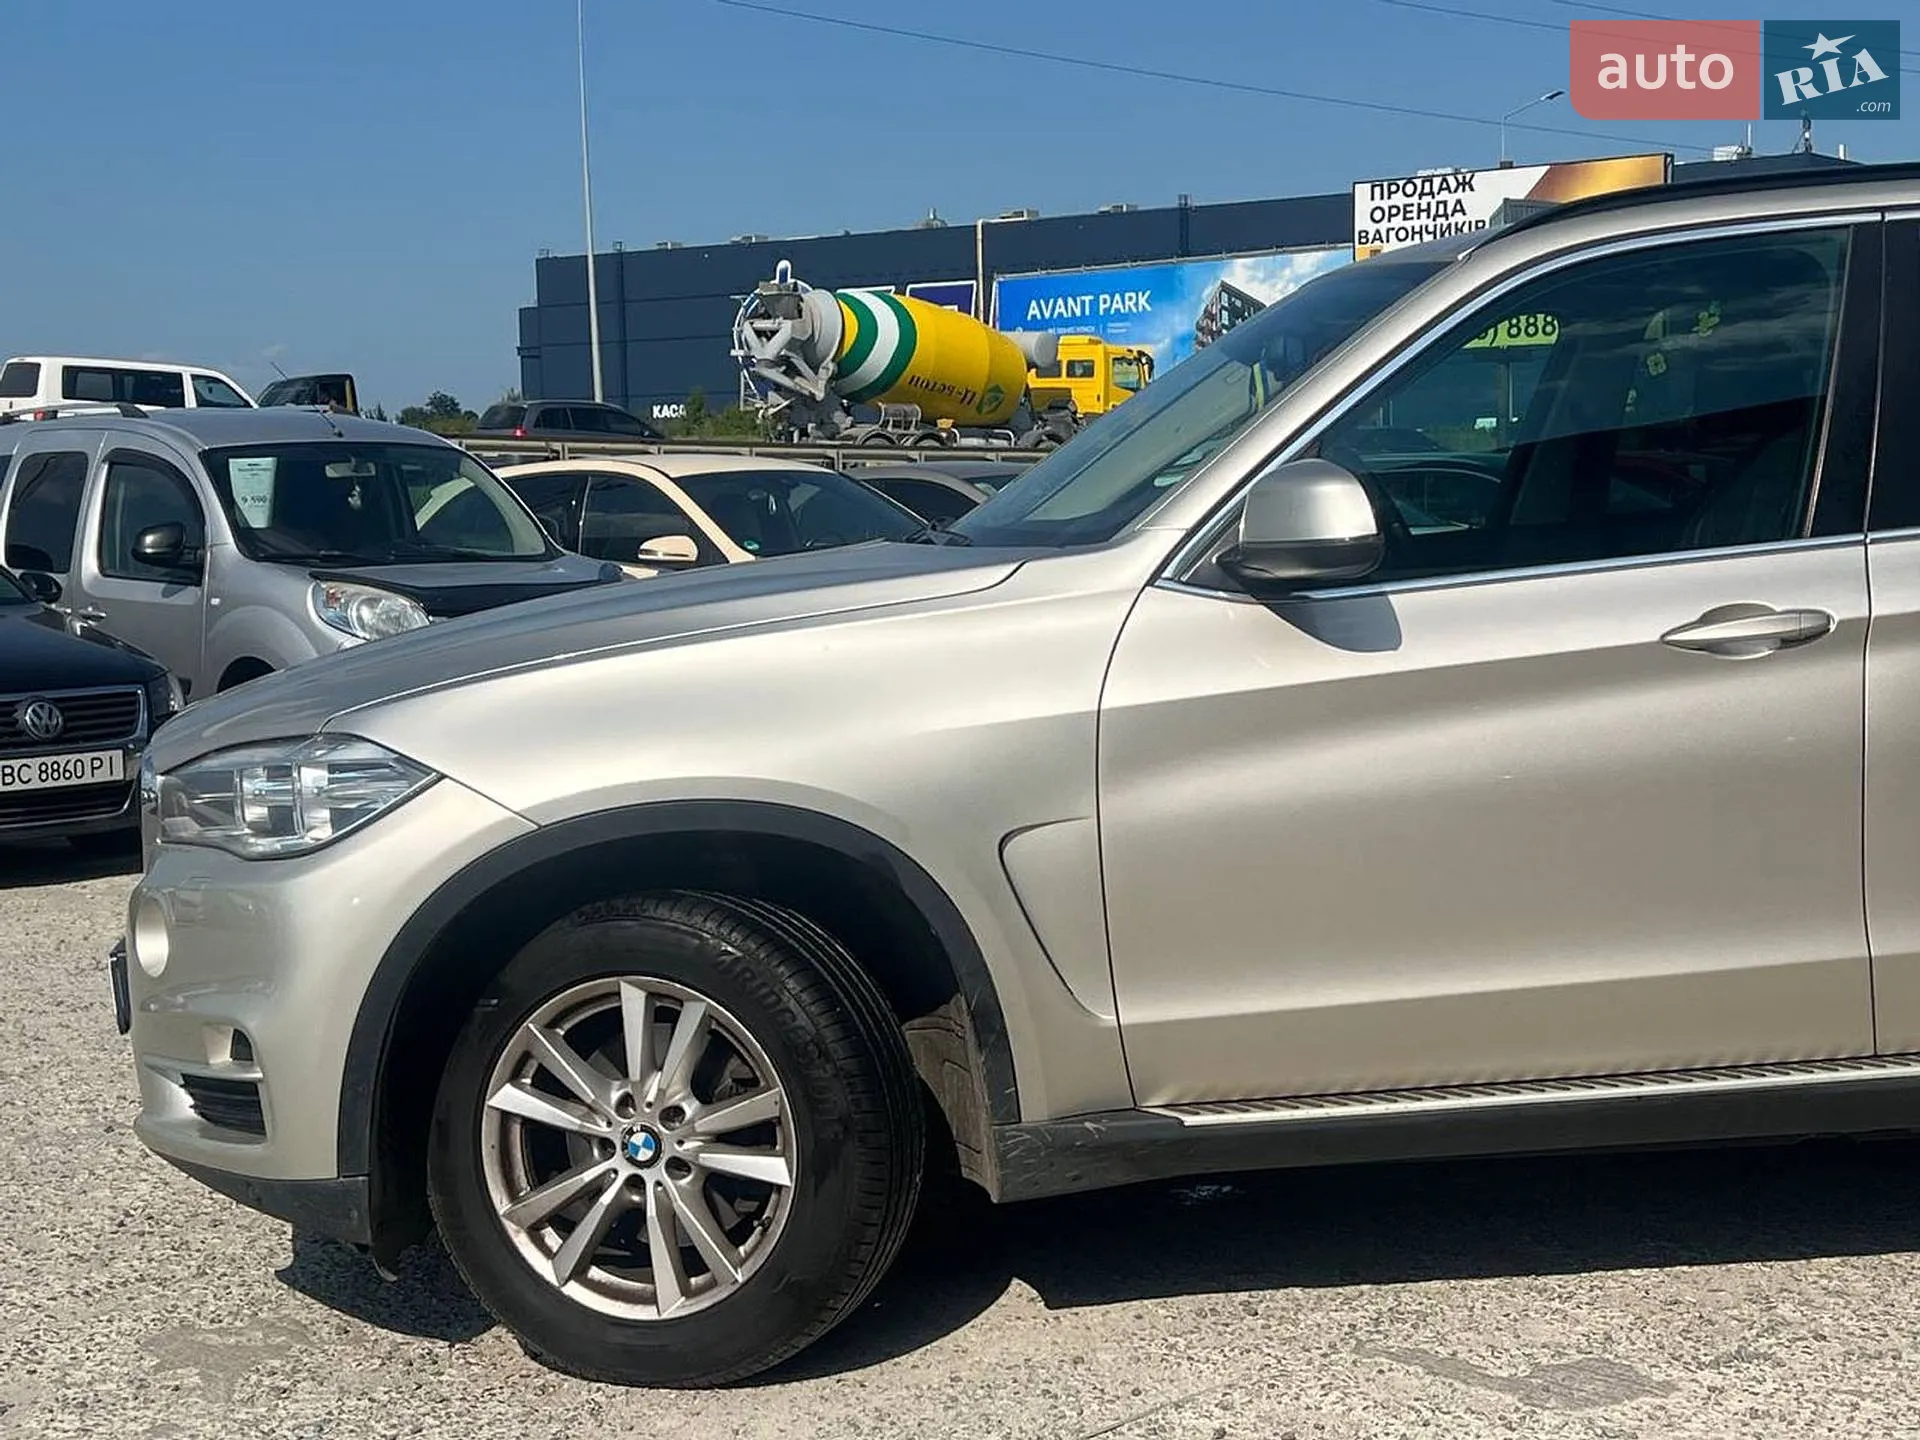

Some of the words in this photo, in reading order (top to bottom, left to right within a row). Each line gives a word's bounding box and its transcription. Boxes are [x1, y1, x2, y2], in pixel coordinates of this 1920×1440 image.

[1370, 174, 1475, 201] ПРОДАЖ
[1369, 198, 1467, 224] ОРЕНДА
[1027, 295, 1095, 321] AVANT
[1099, 290, 1152, 315] PARK
[1507, 314, 1556, 338] 888
[1, 764, 32, 786] BC
[38, 759, 85, 782] 8860
[90, 755, 114, 778] PI
